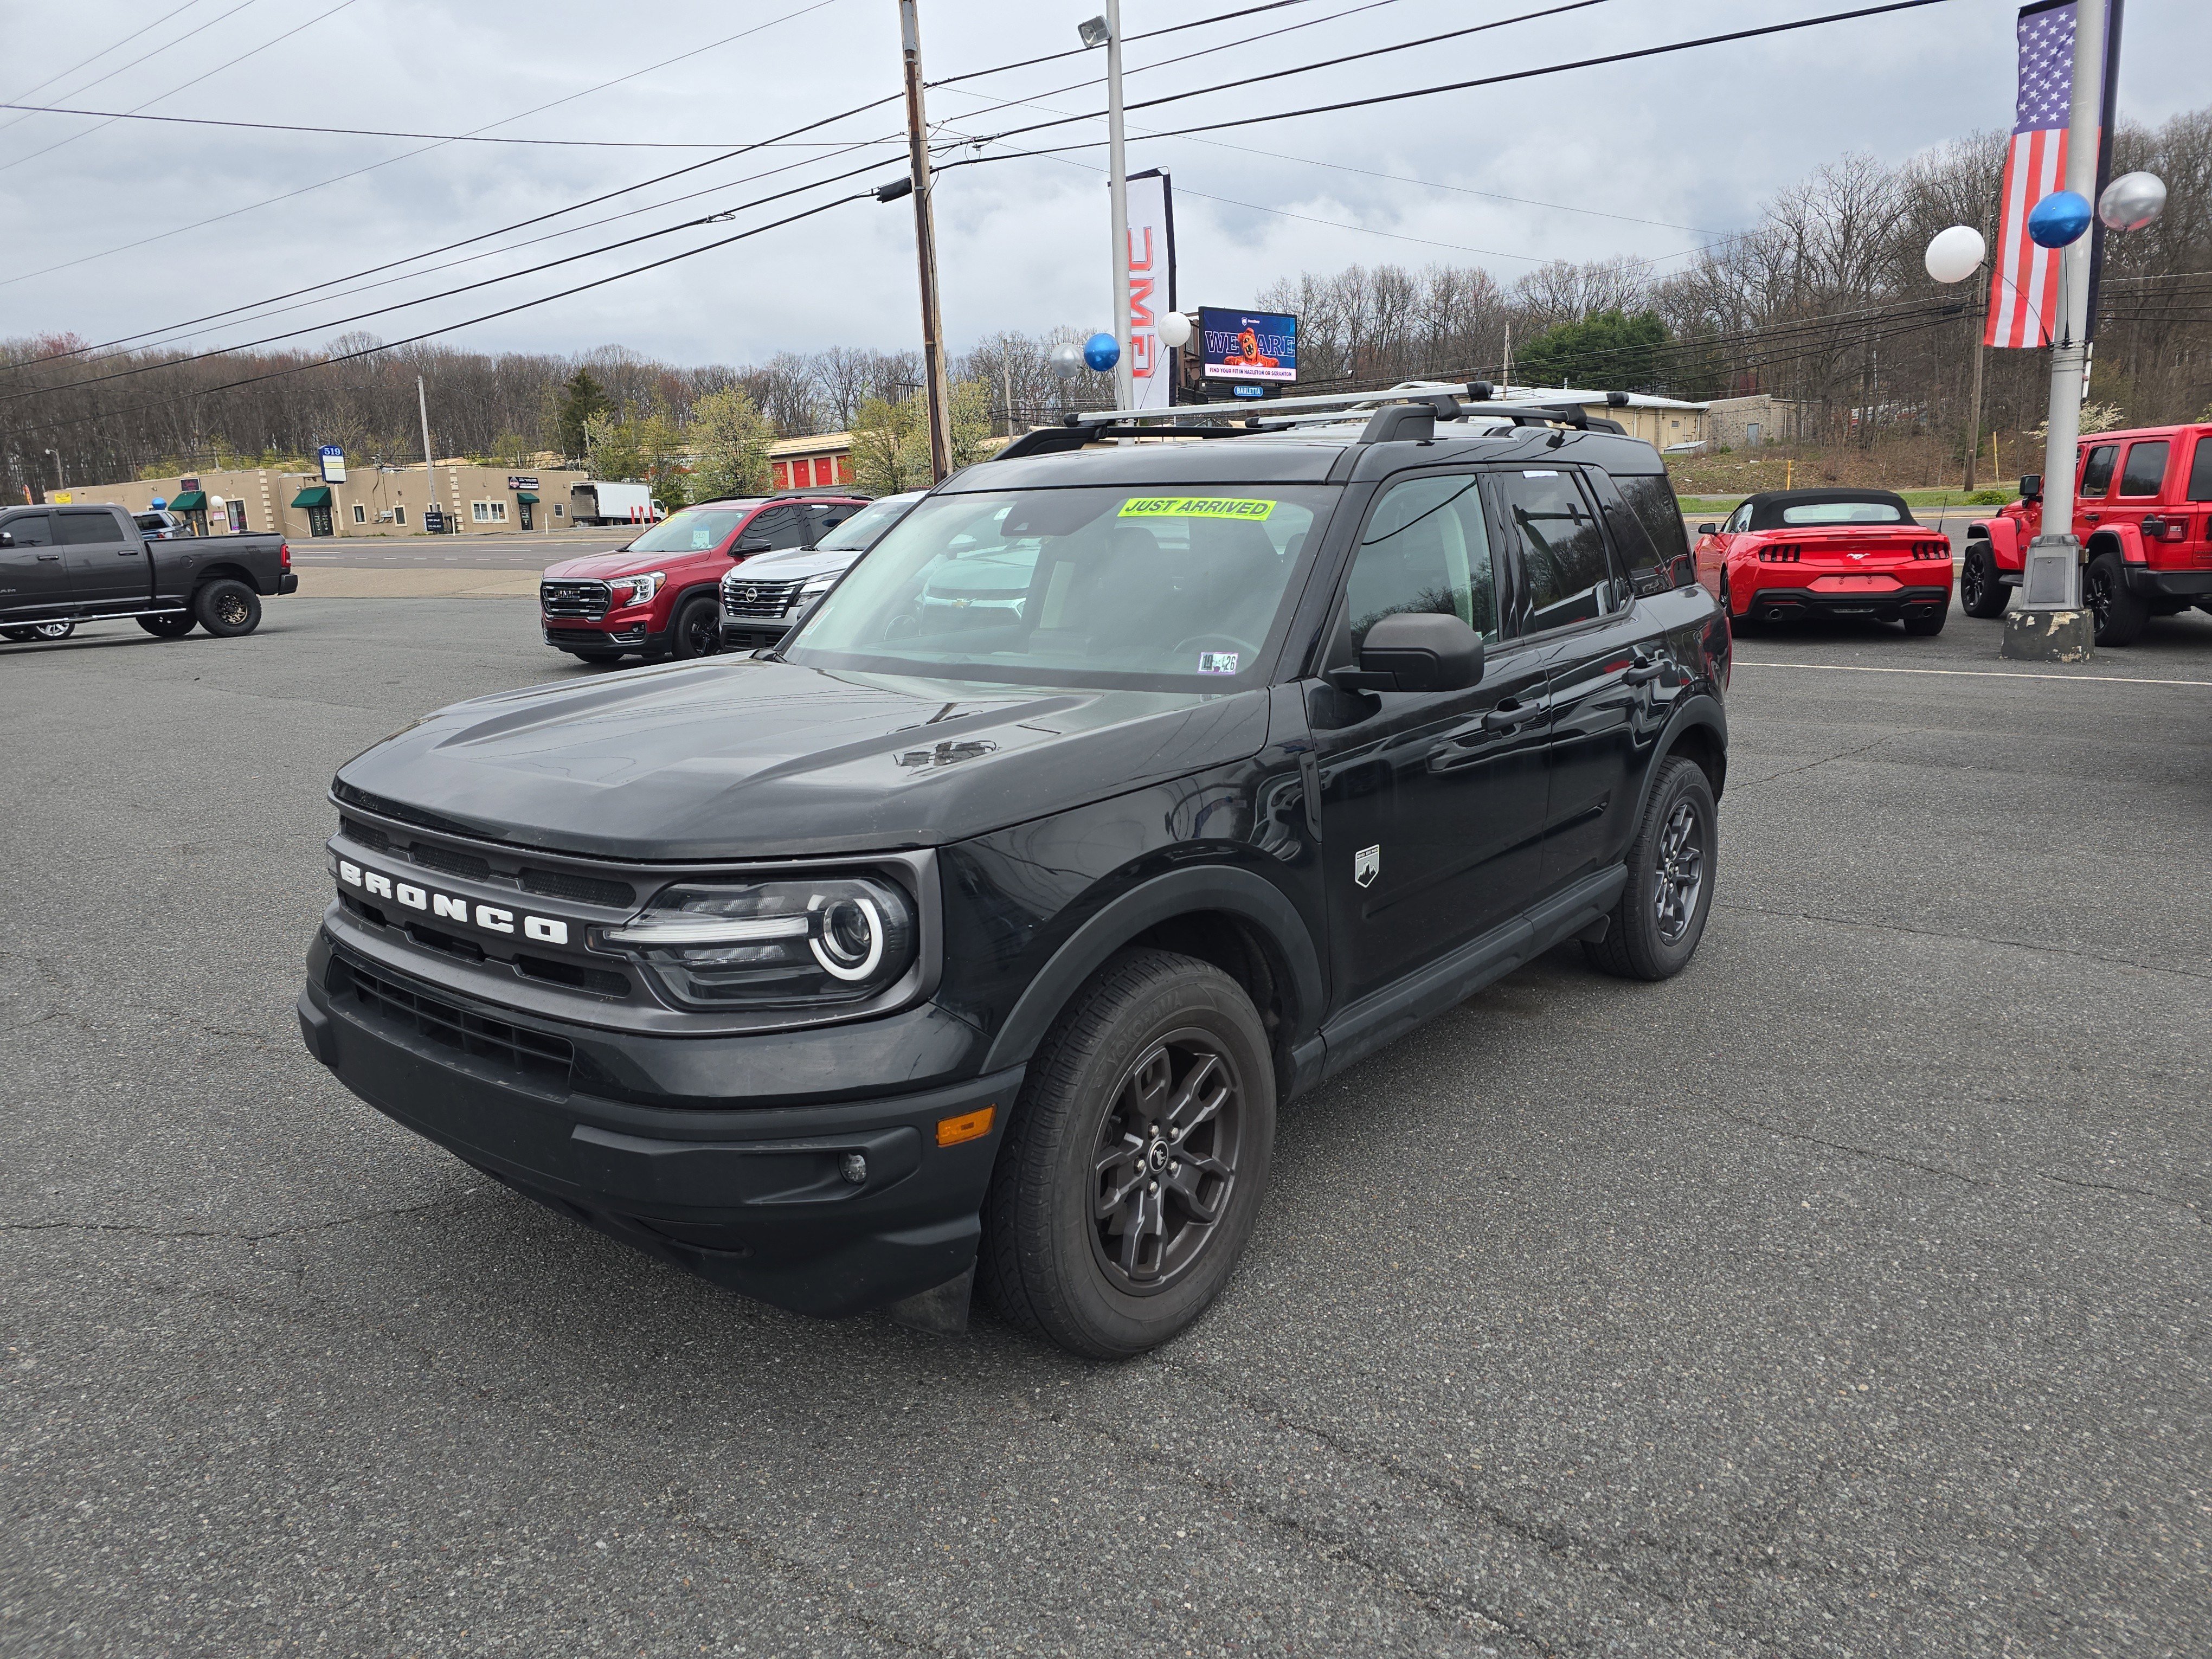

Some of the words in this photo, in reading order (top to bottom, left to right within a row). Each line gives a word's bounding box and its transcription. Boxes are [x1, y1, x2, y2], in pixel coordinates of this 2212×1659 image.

[1205, 330, 1240, 354] WE
[1256, 333, 1296, 357] ARE
[1237, 387, 1261, 395] BARLETTA
[324, 447, 340, 455] 519
[1125, 500, 1179, 513] JUST
[1176, 500, 1270, 516] ARRIVED
[554, 590, 580, 599] GMC
[1225, 655, 1236, 670] 26
[1366, 847, 1379, 856] BEND
[340, 860, 568, 944] BRONCO
[1106, 990, 1183, 1067] YOKOHAMA
